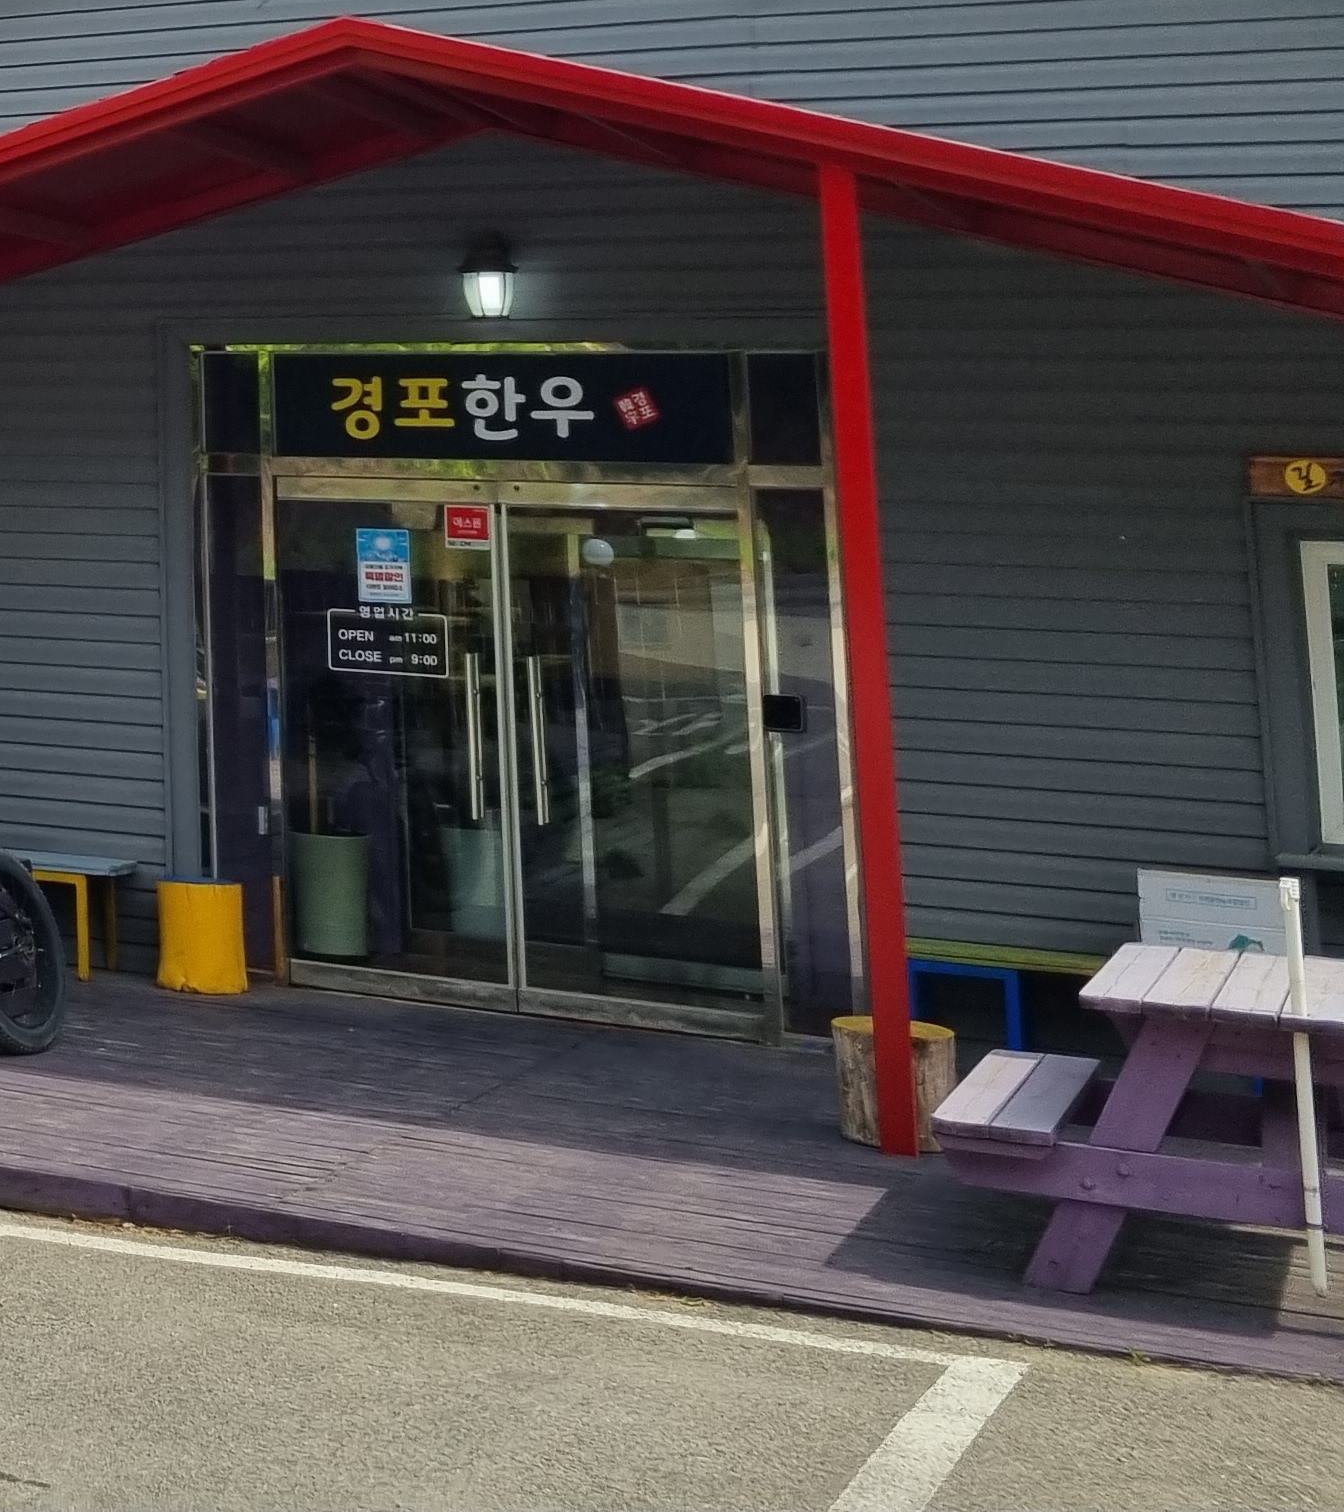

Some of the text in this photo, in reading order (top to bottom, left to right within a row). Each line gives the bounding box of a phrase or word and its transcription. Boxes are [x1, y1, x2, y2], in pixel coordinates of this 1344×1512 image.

[331, 373, 595, 440] 경포한우
[359, 605, 414, 621] 영업시간
[338, 629, 374, 642] OPEN
[404, 632, 438, 644] 11:00
[338, 649, 438, 666] CLOSE pm 9:00
